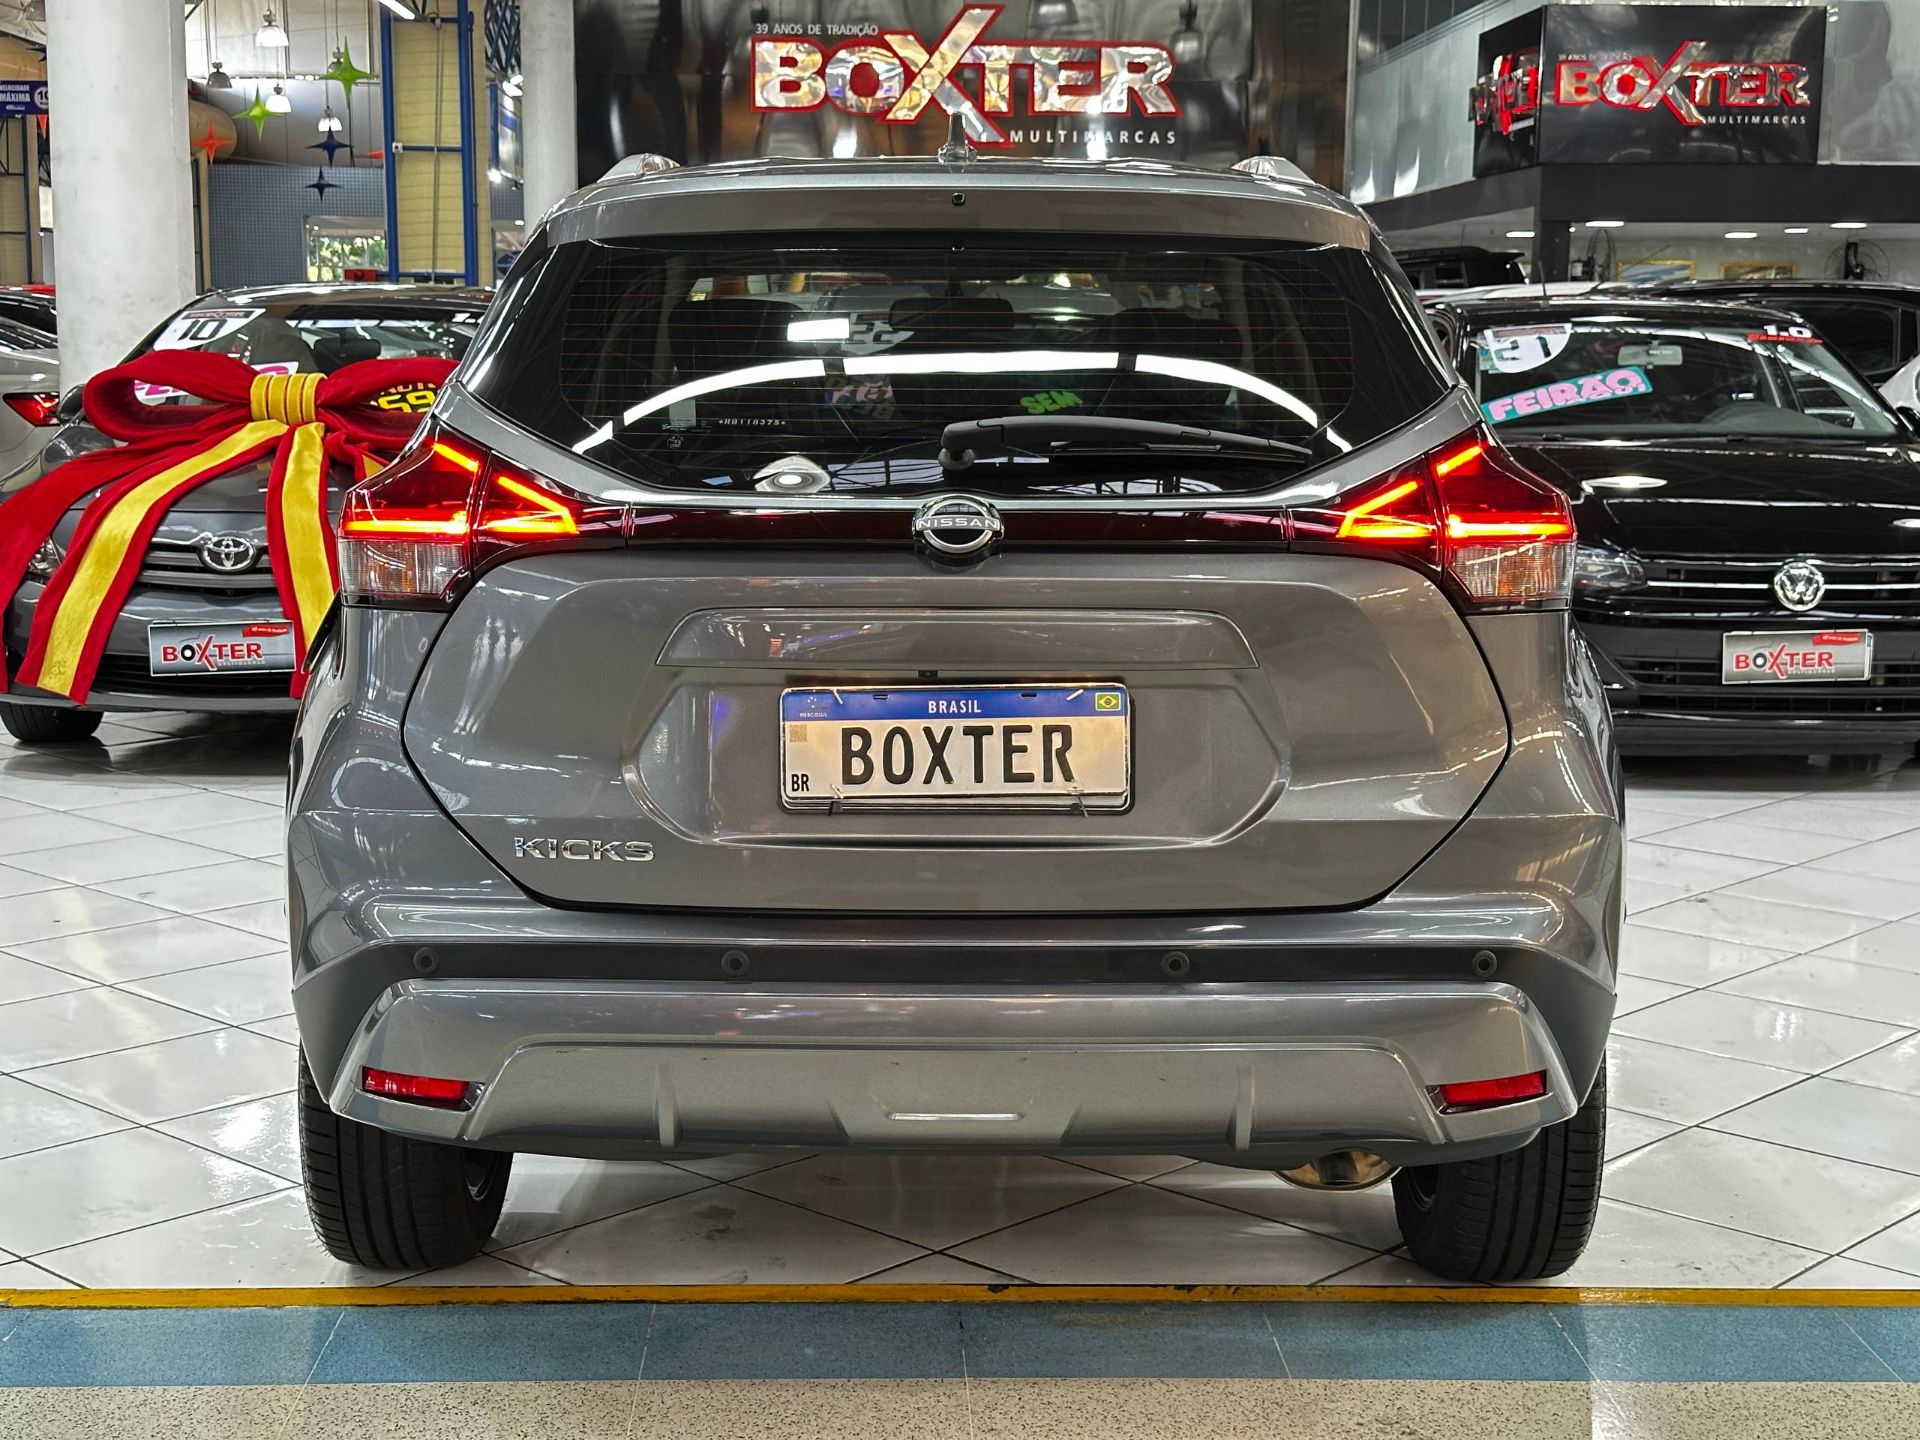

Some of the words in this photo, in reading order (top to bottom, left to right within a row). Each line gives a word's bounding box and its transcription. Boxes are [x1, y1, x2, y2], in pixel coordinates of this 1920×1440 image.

[755, 23, 768, 35] 39
[773, 23, 803, 35] ANOS
[807, 23, 822, 35] DE
[826, 22, 879, 37] TRADIÇÃO
[751, 4, 1182, 148] BOXTER
[1555, 40, 1811, 126] BOXTER
[1706, 114, 1807, 125] MULTIMARCAS
[1009, 129, 1177, 145] MULTIMARCAS
[177, 319, 228, 342] 10
[1763, 324, 1812, 338] 1.0
[1019, 391, 1083, 415] SEM
[918, 518, 998, 529] NISSAN
[161, 634, 265, 671] BOXTER
[1733, 642, 1834, 679] BOXTER
[928, 699, 982, 714] BRASIL
[841, 724, 1074, 785] BOXTER
[791, 774, 810, 792] BR
[514, 837, 654, 861] KICKS
